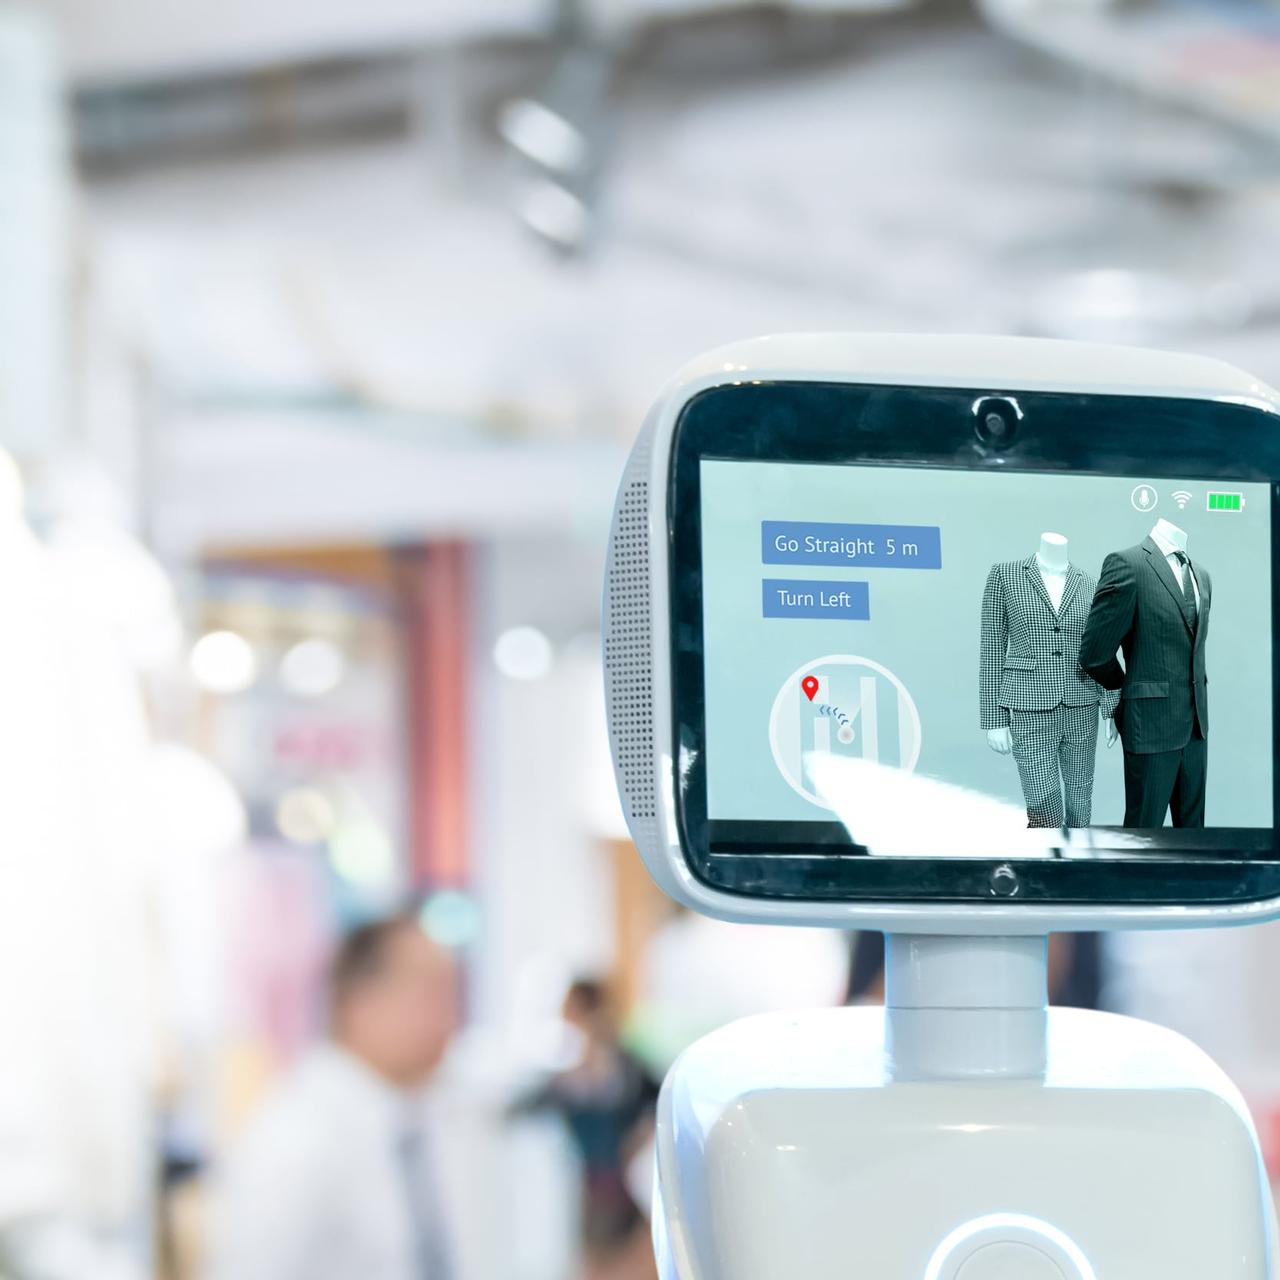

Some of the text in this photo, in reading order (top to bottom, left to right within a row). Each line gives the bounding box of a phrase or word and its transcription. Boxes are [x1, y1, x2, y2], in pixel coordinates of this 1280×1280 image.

[775, 535, 918, 558] Go Straight 5 m
[777, 590, 852, 608] Turn Left
